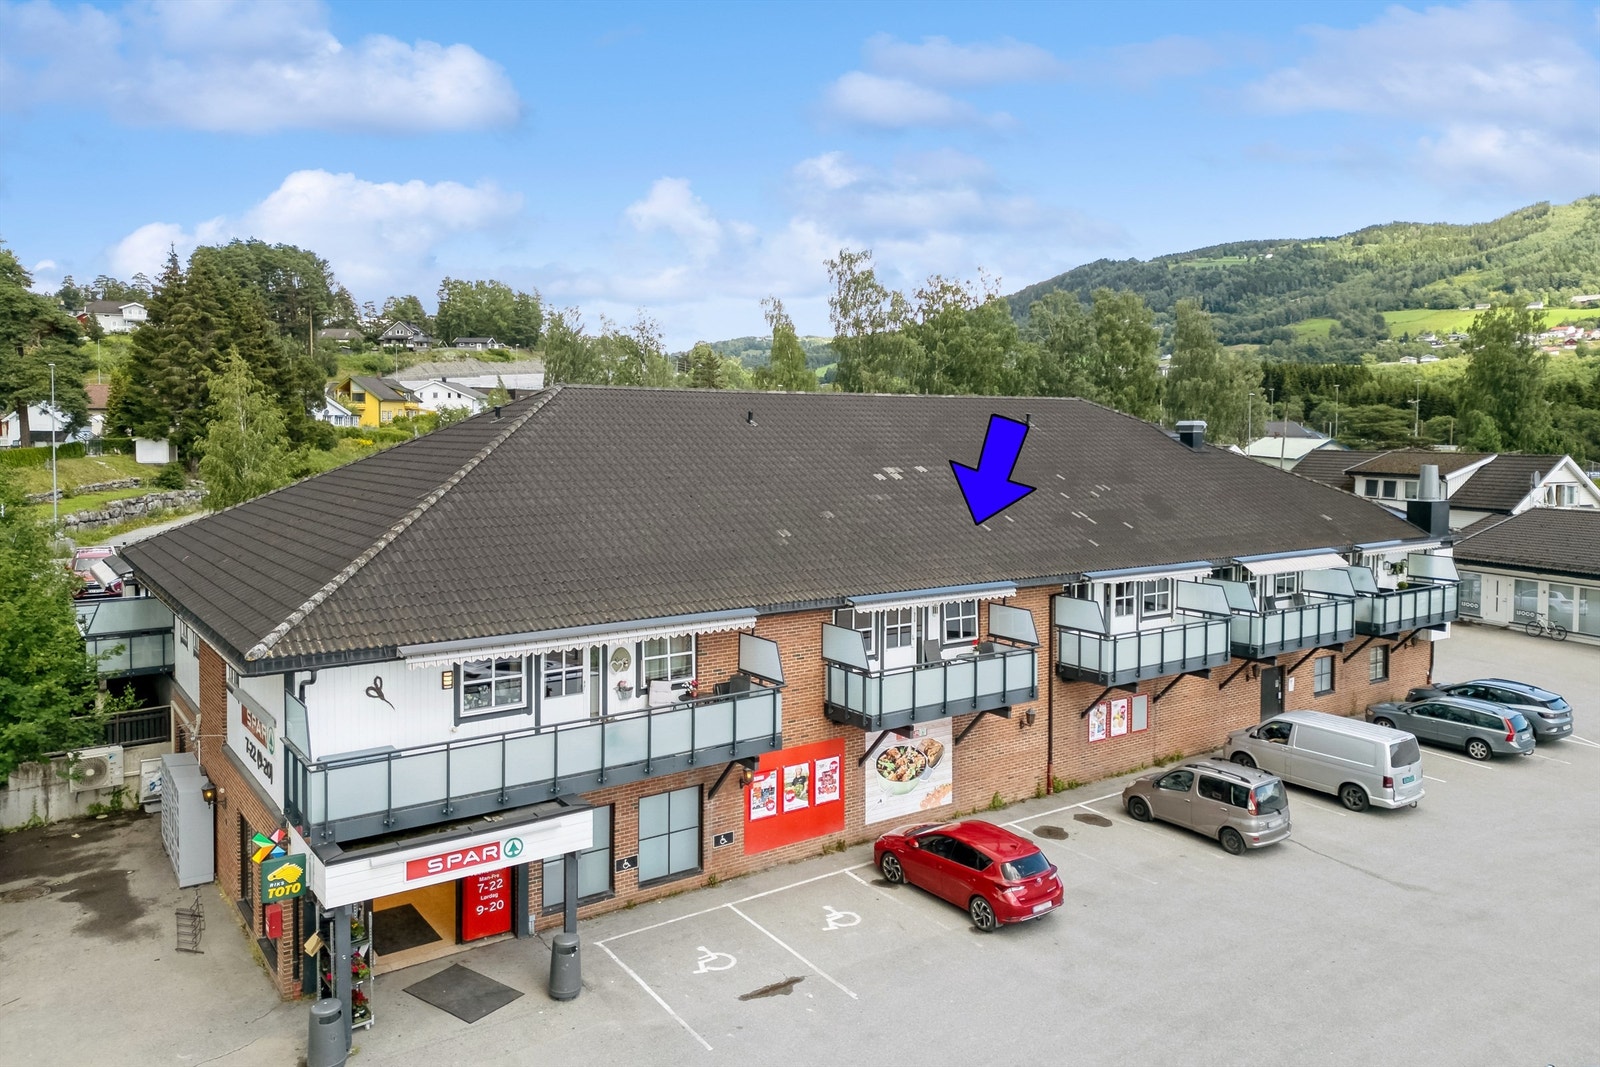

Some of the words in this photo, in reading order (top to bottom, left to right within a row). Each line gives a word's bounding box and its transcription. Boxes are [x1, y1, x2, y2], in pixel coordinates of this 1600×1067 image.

[246, 708, 267, 740] SPAR
[245, 736, 257, 763] 7-22
[427, 845, 498, 873] SPAR
[268, 882, 302, 899] TOTO
[477, 878, 504, 894] 7-22
[480, 892, 499, 901] Lørdag
[476, 899, 504, 916] 9-20
